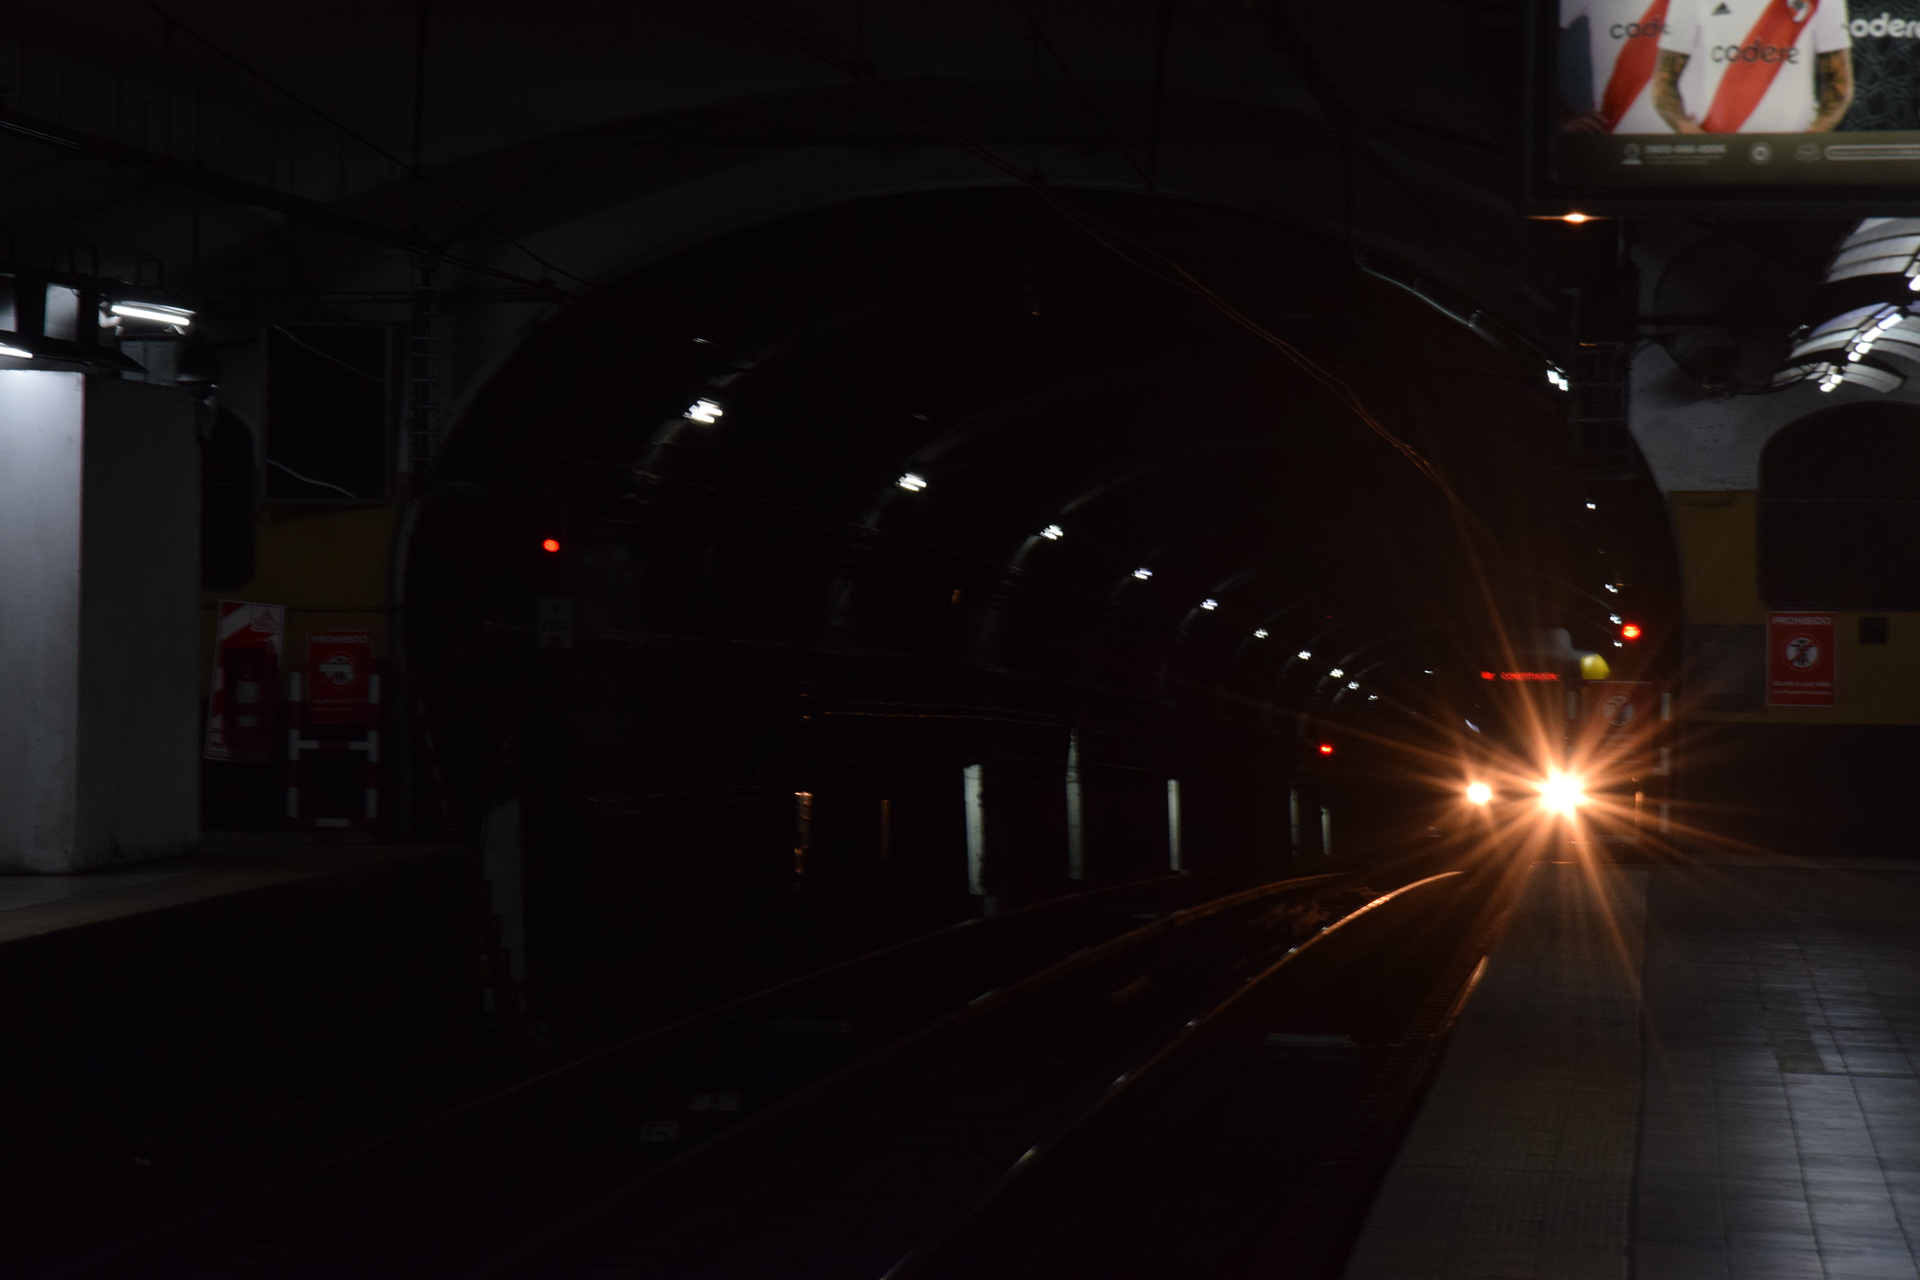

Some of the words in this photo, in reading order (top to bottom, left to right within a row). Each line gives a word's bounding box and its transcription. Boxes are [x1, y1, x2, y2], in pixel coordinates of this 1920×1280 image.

[1711, 38, 1800, 64] codere
[1772, 616, 1831, 625] PROHIBIDO
[311, 634, 368, 644] PROHIBIDO
